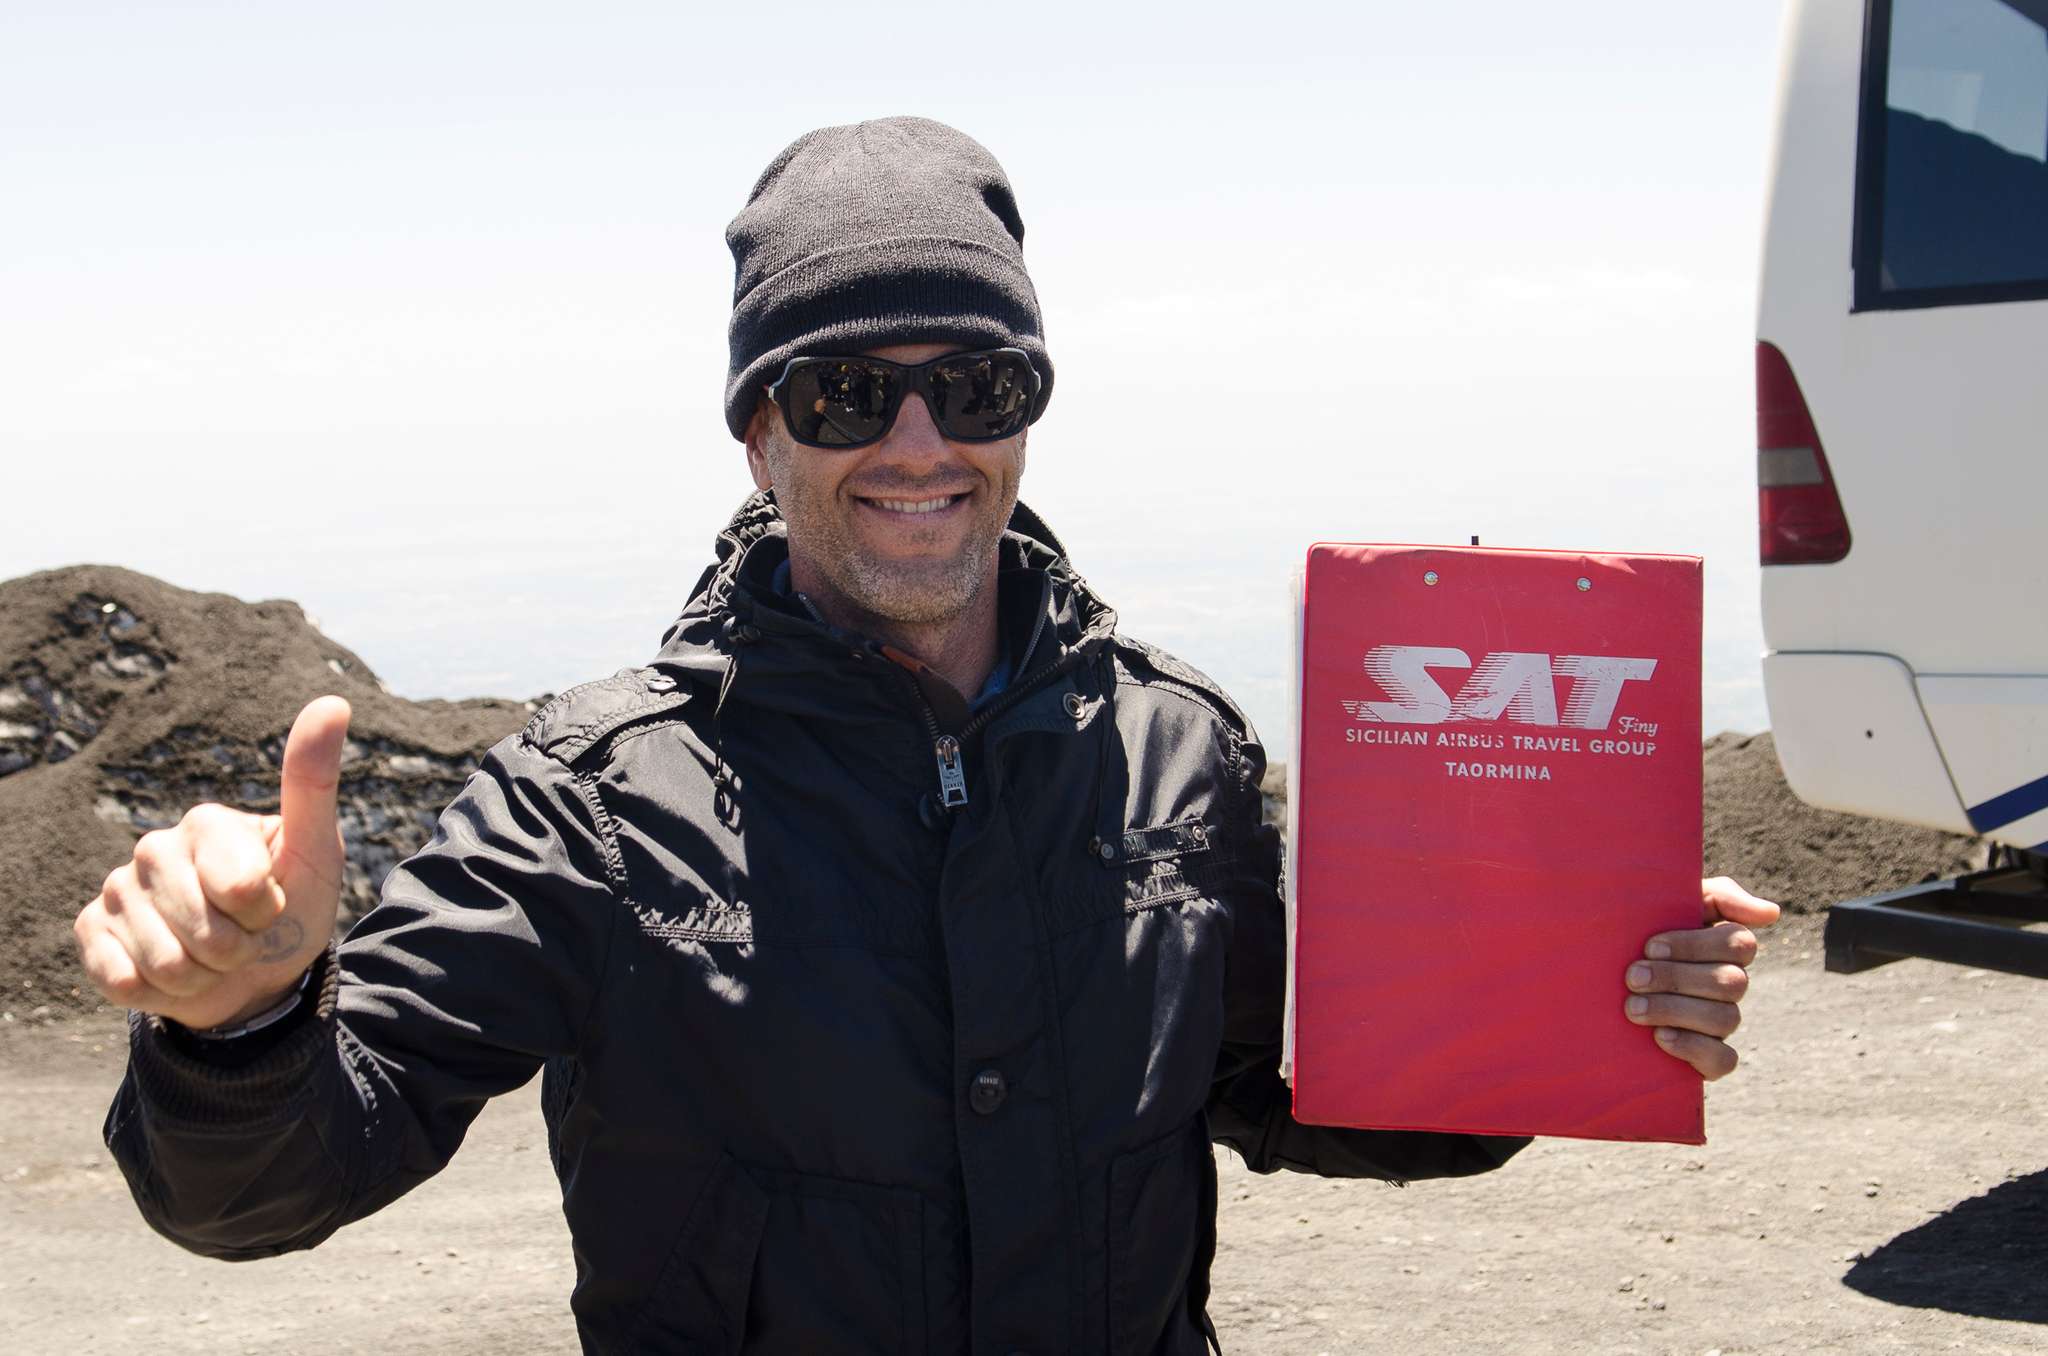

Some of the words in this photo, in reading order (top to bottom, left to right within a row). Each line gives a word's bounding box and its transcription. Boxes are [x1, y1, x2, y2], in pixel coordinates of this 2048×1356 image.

[1341, 644, 1658, 730] SAT
[1345, 728, 1428, 746] SICILIAN
[1436, 732, 1504, 749] AIRBUS
[1513, 735, 1581, 753] TRAVEL
[1589, 739, 1657, 756] GROUP
[1445, 762, 1552, 780] TAORMINA
